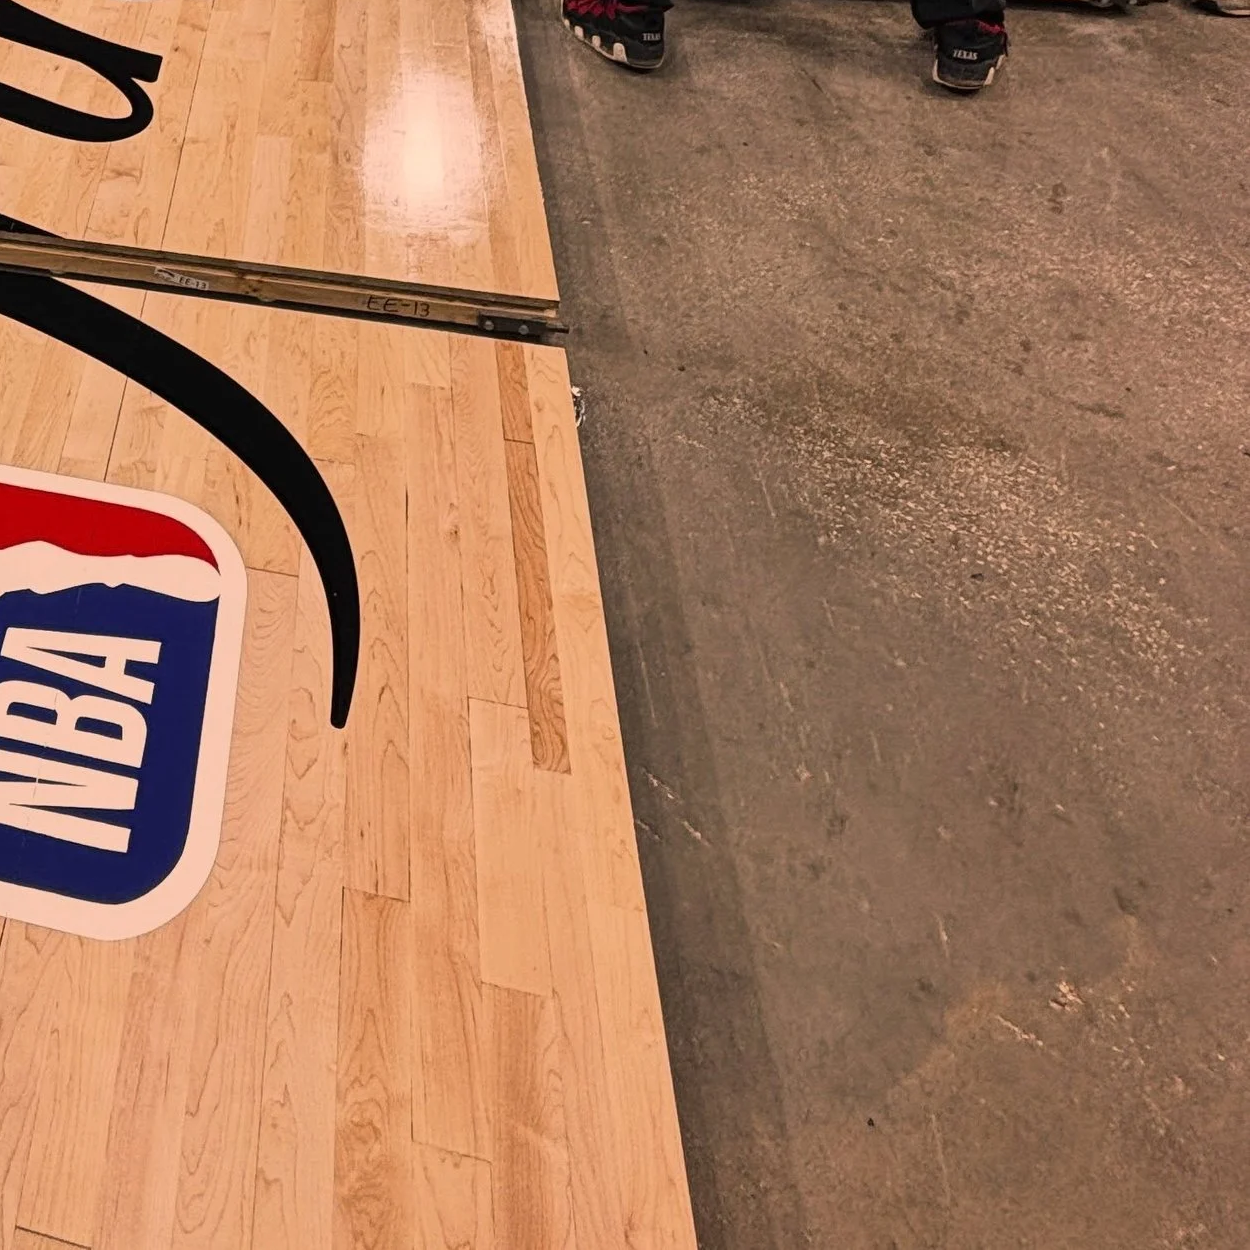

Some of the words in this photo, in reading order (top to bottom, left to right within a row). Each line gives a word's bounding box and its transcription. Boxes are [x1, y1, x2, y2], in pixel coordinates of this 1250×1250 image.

[953, 49, 979, 61] TEXAS
[179, 276, 207, 290] EE-13
[366, 294, 431, 318] EE-13
